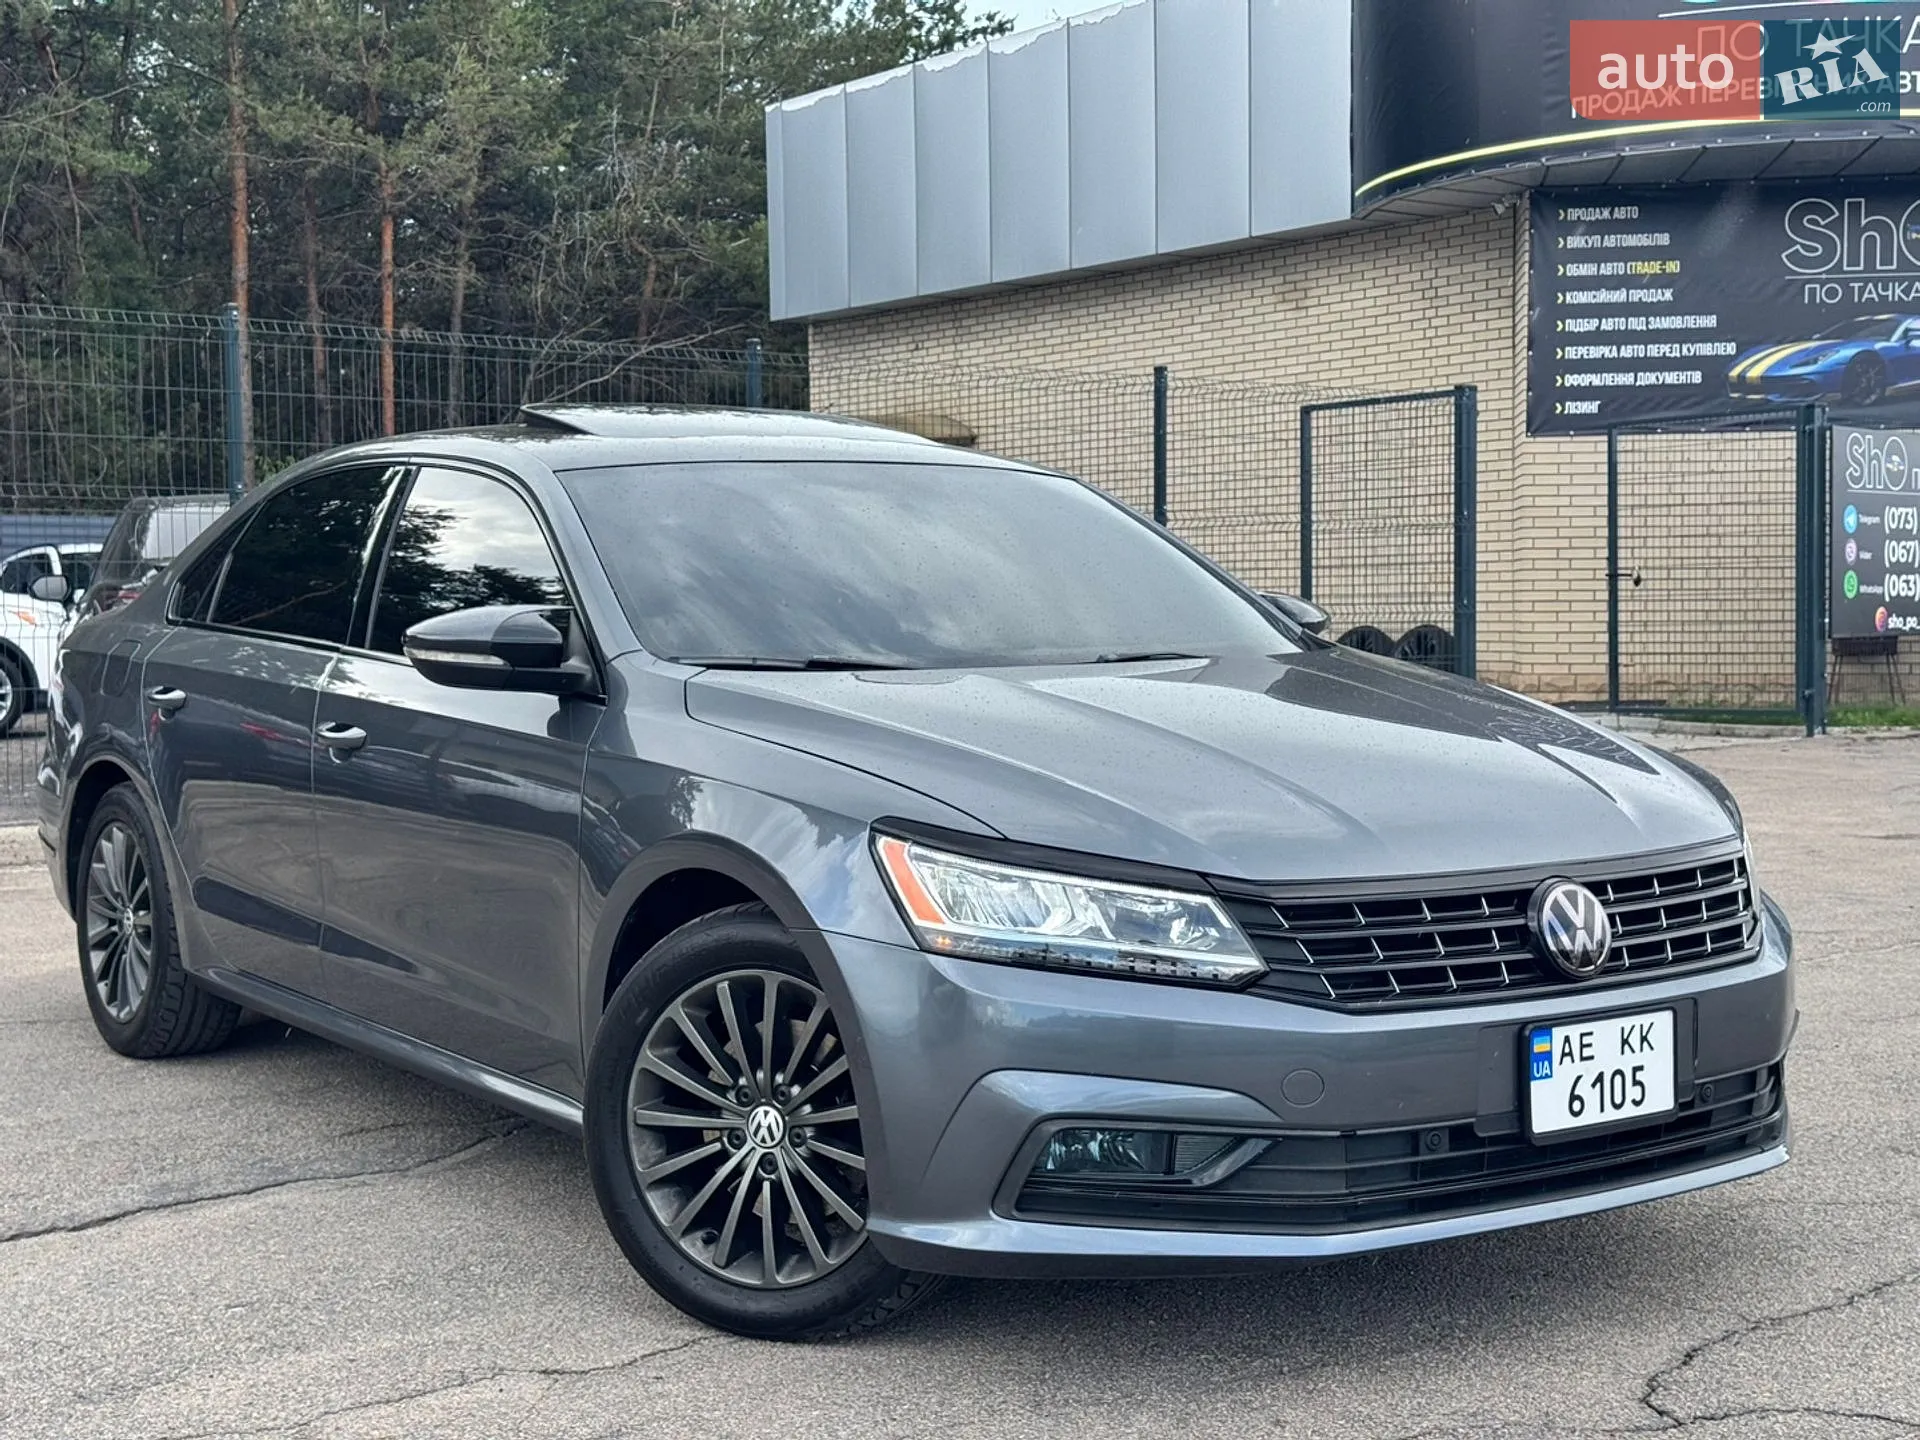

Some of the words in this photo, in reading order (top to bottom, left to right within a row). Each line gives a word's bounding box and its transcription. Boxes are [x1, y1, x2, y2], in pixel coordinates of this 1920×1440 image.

[1571, 84, 1682, 119] ПРОДАЖ
[1567, 207, 1612, 221] ПРОДАЖ
[1613, 206, 1639, 219] АВТО
[1566, 235, 1601, 249] ВИКУП
[1602, 233, 1670, 247] АВТОМОБІЛІВ
[1781, 198, 1920, 273] Sh
[1566, 263, 1597, 276] ОБМІН
[1599, 262, 1625, 275] АВТО
[1565, 288, 1627, 304] КОМІСІЙНИЙ
[1628, 289, 1673, 303] ПРОДАЖ
[1804, 282, 1842, 304] ПО
[1565, 318, 1599, 332] ПІДБІР
[1600, 318, 1626, 331] АВТО
[1628, 317, 1647, 331] ПІД
[1648, 315, 1717, 330] ЗАМОВЛЕННЯ
[1564, 345, 1618, 359] ПЕРЕВІРКА
[1619, 345, 1645, 358] АВТО
[1647, 343, 1681, 358] ПЕРЕД
[1682, 342, 1736, 356] КУПІВЛЕЮ
[1564, 373, 1634, 387] ОФОРМЛЕННЯ
[1635, 371, 1702, 386] ДОКУМЕНТІВ
[1564, 400, 1601, 414] ЛІЗИНГ
[1884, 506, 1918, 535] (073)
[1884, 540, 1920, 568] (067)
[1884, 573, 1920, 602] (063)
[1559, 1031, 1595, 1066] AE
[1620, 1022, 1655, 1056] KK
[1534, 1060, 1551, 1078] UA
[1568, 1064, 1646, 1118] 6105
